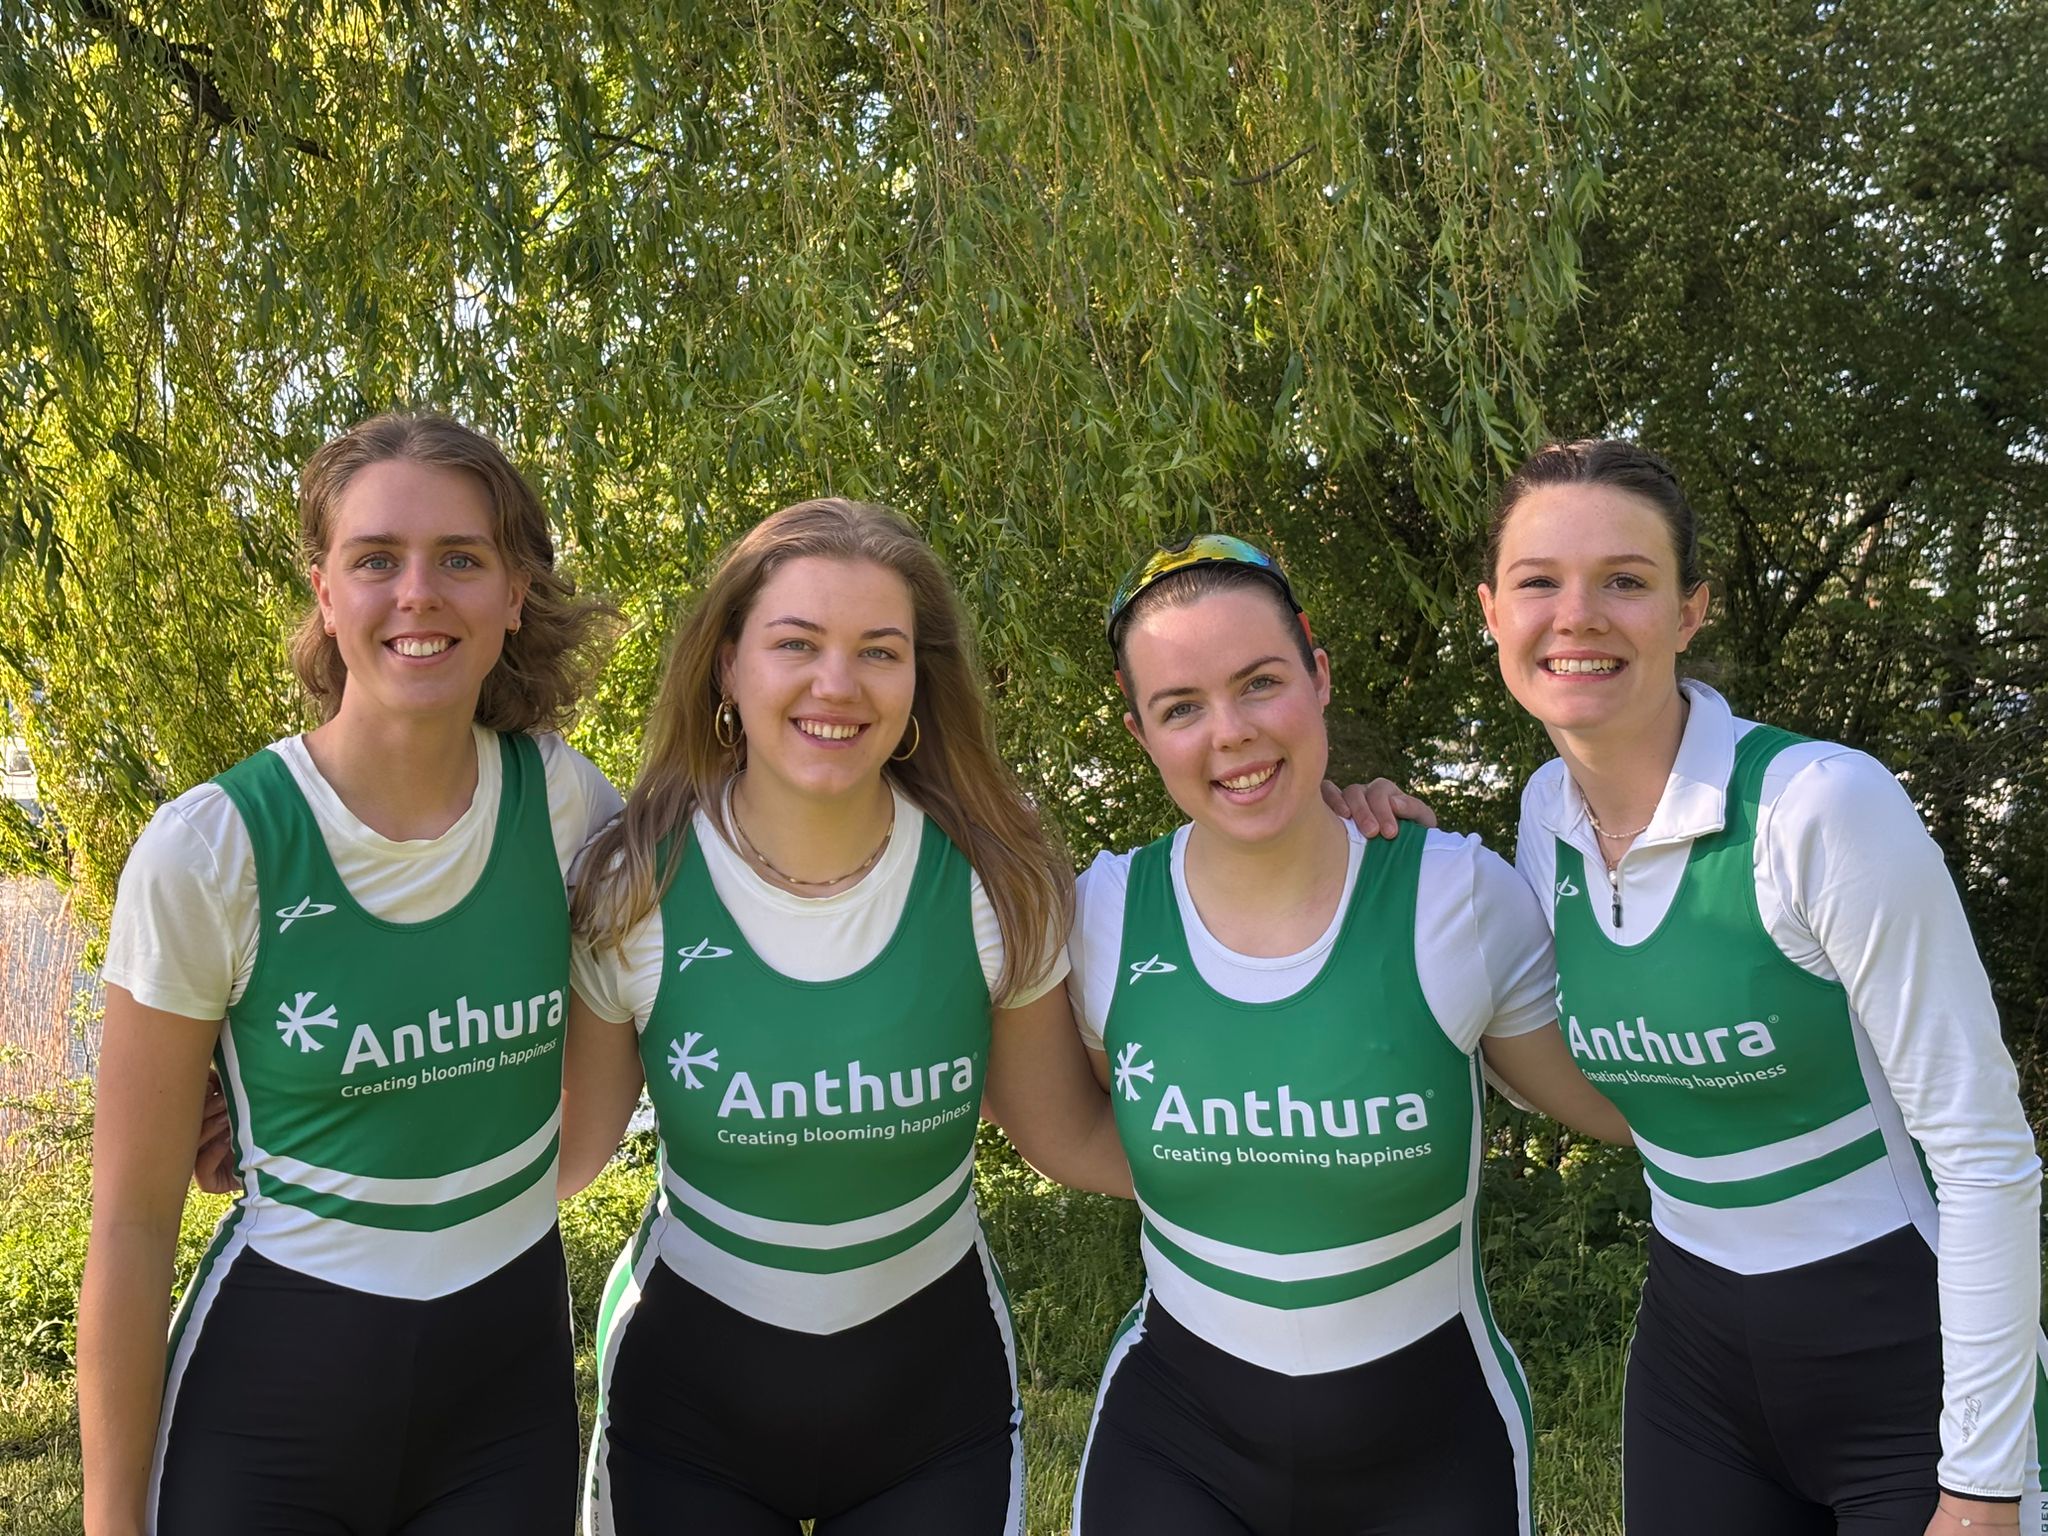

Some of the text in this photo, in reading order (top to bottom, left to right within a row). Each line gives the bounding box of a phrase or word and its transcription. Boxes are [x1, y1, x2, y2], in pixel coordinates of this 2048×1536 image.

[341, 990, 563, 1076] Anthura
[341, 1038, 558, 1098] Creating blooming happiness
[1629, 1069, 1694, 1090] blooming
[1695, 1063, 1788, 1089] happiness
[718, 1101, 972, 1147] Creating blooming happiness
[1153, 1143, 1432, 1169] Creating blooming happiness
